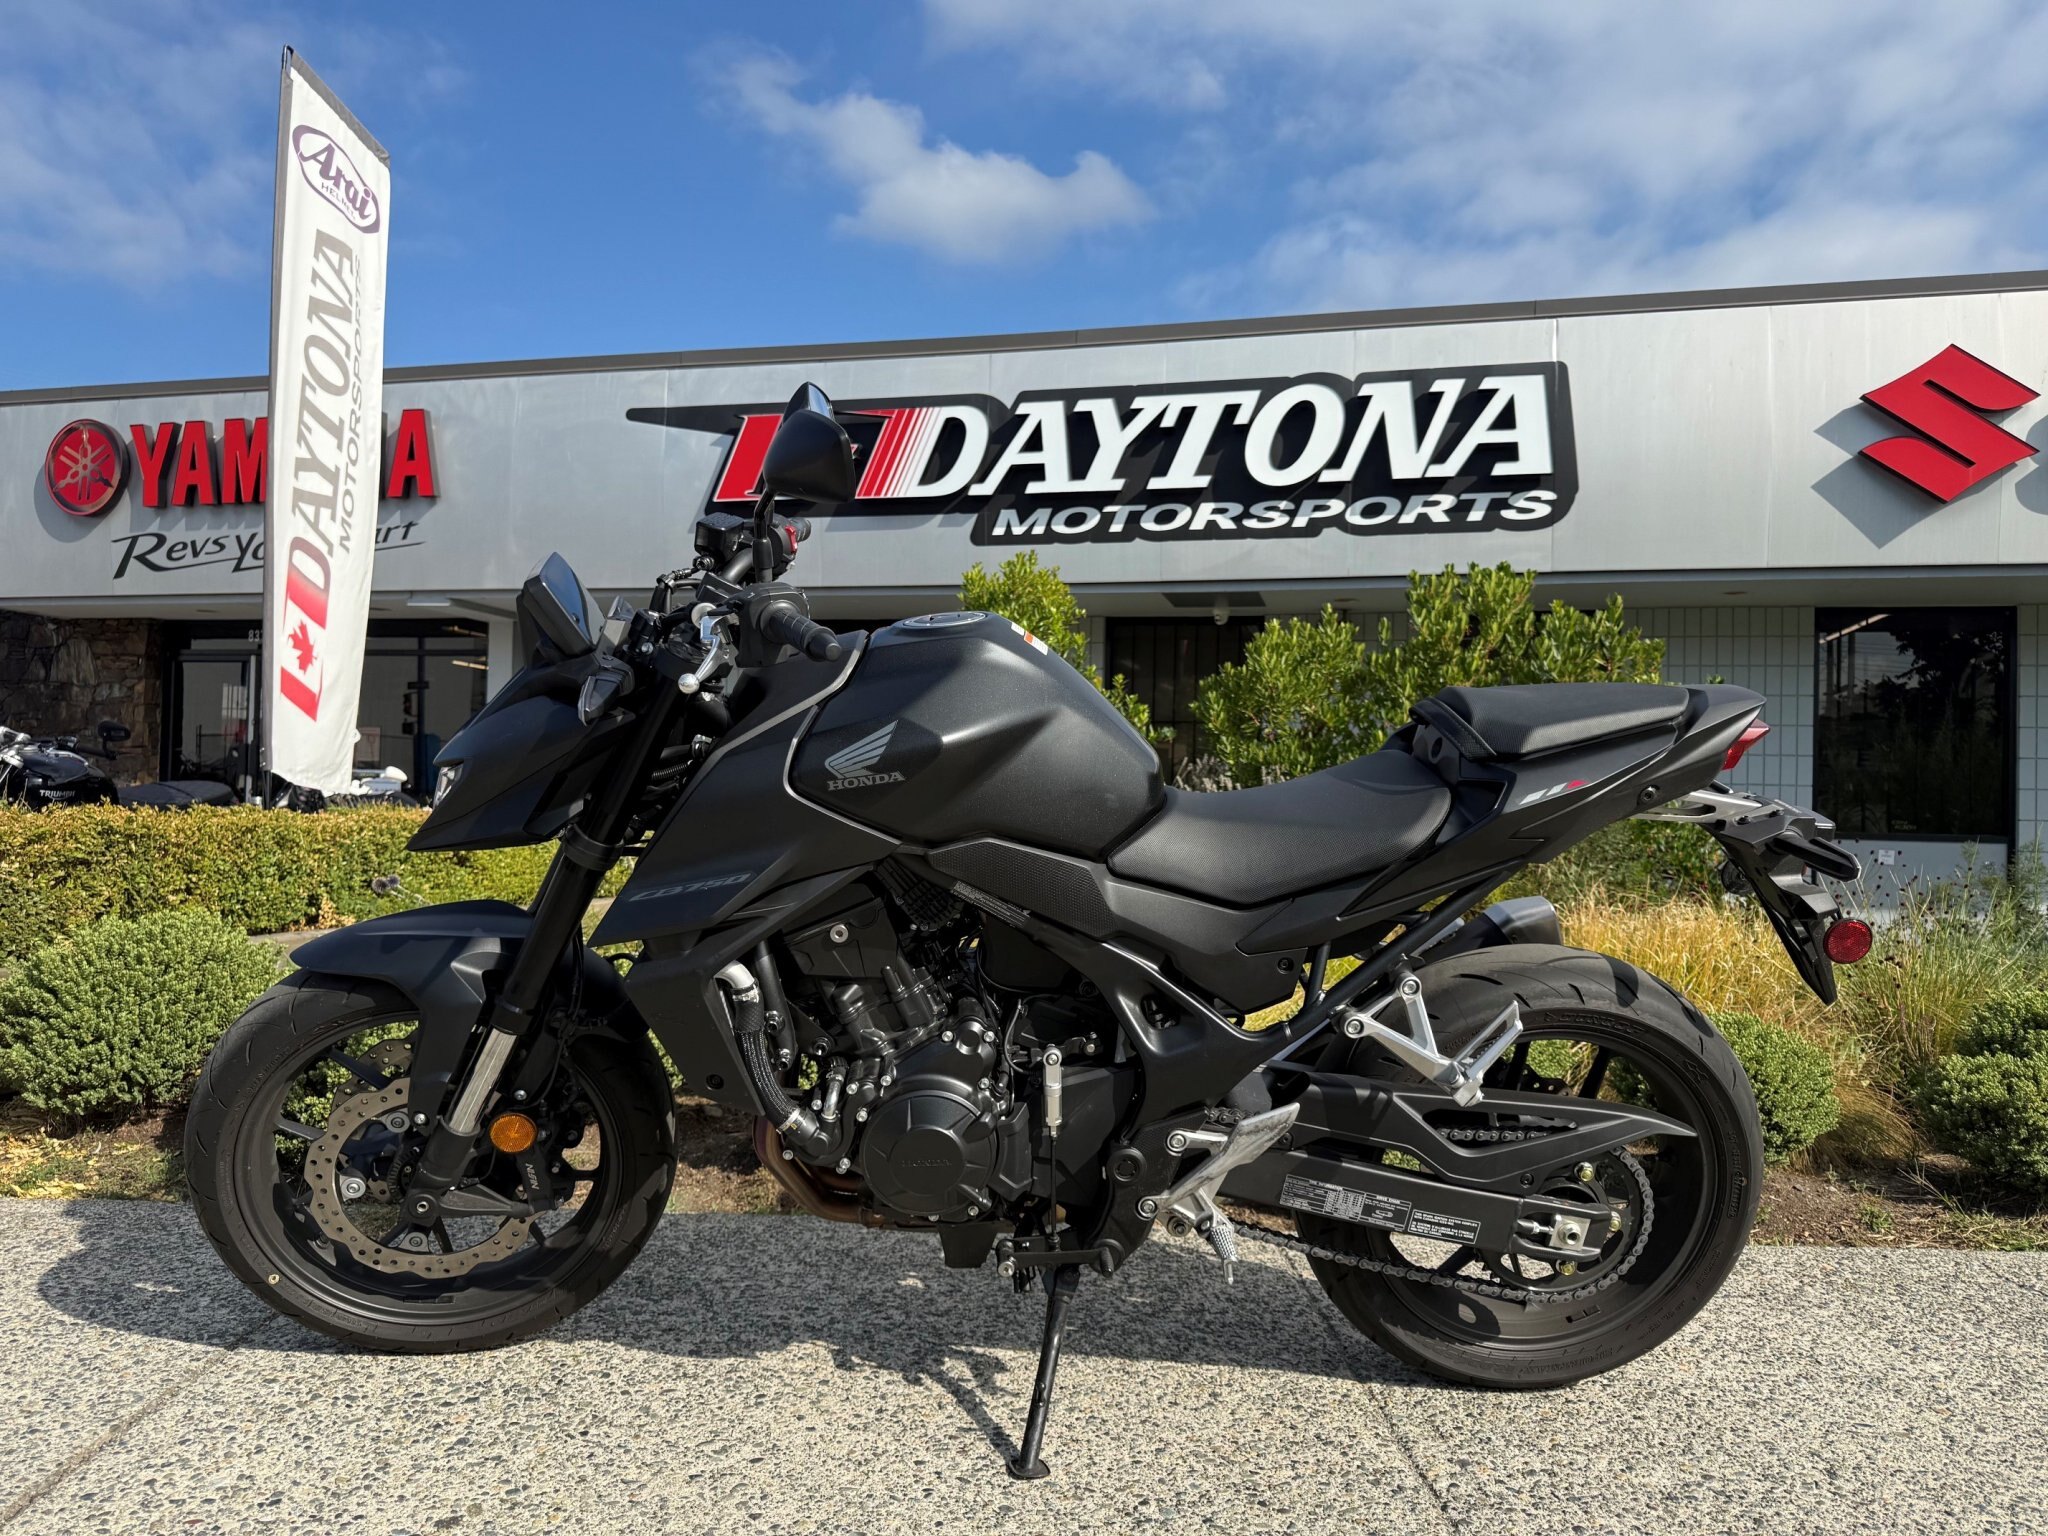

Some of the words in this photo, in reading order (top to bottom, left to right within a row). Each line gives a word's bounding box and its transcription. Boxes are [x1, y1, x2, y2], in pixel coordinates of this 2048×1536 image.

[299, 142, 372, 220] Arai
[283, 228, 354, 630] DAYTONA
[339, 253, 364, 554] MOTORSPORTS
[872, 374, 1554, 500] DAYTONA
[129, 408, 435, 508] YAMA
[991, 489, 1558, 537] MOTORSPORTS
[111, 532, 231, 580] Revs
[39, 789, 76, 798] TRIUMPH
[826, 771, 906, 792] HONDA
